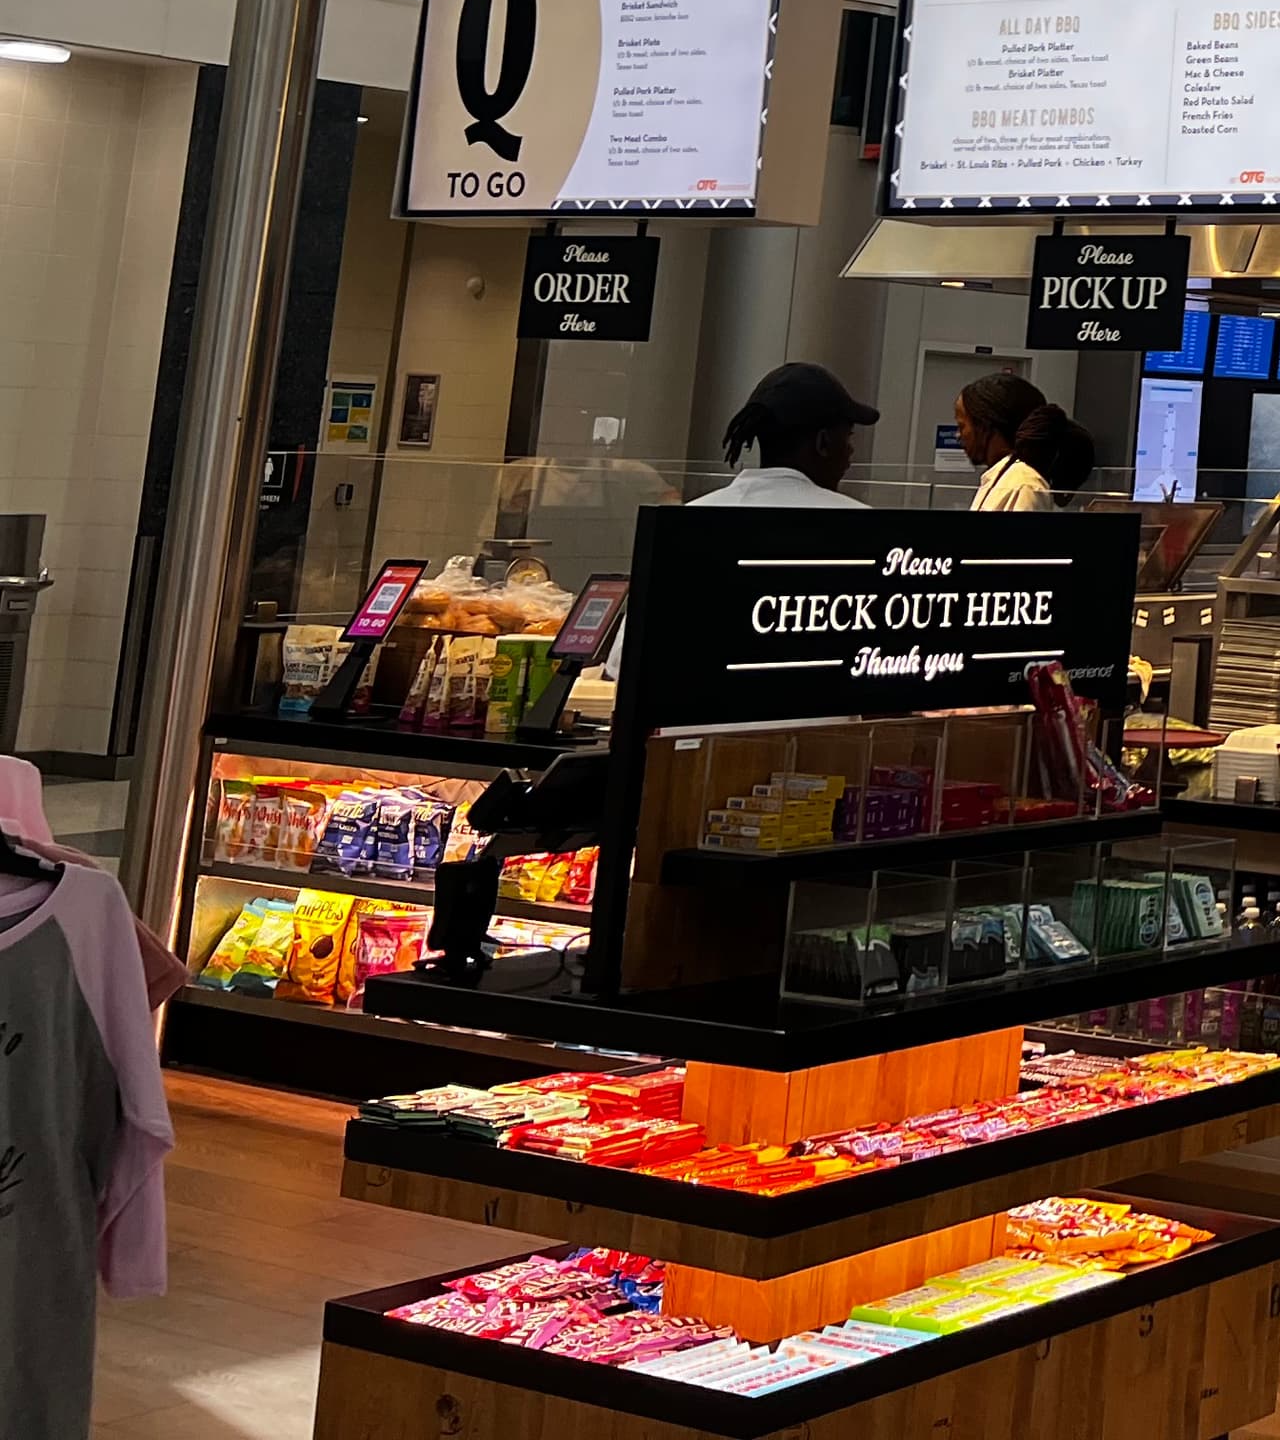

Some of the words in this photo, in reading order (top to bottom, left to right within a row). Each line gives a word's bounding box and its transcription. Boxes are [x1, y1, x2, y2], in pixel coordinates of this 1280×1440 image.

[621, 1, 645, 10] Brisket
[646, 0, 678, 9] Sandwich
[1000, 18, 1020, 36] ALL
[1025, 17, 1050, 35] DAY
[1055, 16, 1080, 34] BBQ
[1213, 12, 1240, 31] BBQ
[1002, 44, 1026, 54] Pulled
[1048, 41, 1074, 52] Platter
[1186, 41, 1212, 50] Baked
[1214, 40, 1239, 50] Beans
[1186, 55, 1212, 64] Green
[1214, 55, 1239, 64] Beans
[1008, 69, 1035, 79] Brisket
[1037, 68, 1064, 78] Platter
[1184, 70, 1201, 78] Mac
[1203, 69, 1210, 78] &
[1212, 68, 1245, 78] Cheese
[613, 87, 635, 96] Pulled
[653, 86, 676, 94] Platter
[1184, 83, 1221, 93] Coleslaw
[1183, 97, 1199, 107] Red
[1201, 96, 1229, 106] Potato
[1231, 95, 1254, 105] Salad
[971, 110, 996, 129] BBQ
[1001, 108, 1036, 127] MEAT
[1040, 107, 1095, 127] COMBOS
[1182, 111, 1211, 121] French
[1212, 111, 1233, 120] Fries
[1181, 125, 1214, 135] Roasted
[1216, 124, 1238, 134] Corn
[920, 160, 947, 170] Brisket
[969, 159, 989, 169] Louis
[1017, 158, 1043, 168] Pulled
[1072, 158, 1105, 167] Chicken
[1116, 157, 1143, 168] Turkey
[1239, 171, 1265, 183] OTG
[447, 172, 479, 198] TO
[486, 171, 526, 198] GO
[697, 179, 718, 191] OTG
[562, 244, 610, 264] Please
[1077, 244, 1134, 266] Please
[533, 272, 631, 304] ORDER
[1039, 276, 1113, 310] PICK
[1121, 275, 1168, 310] UP
[559, 313, 597, 334] Here
[1077, 321, 1121, 343] Here
[881, 546, 953, 577] Please
[751, 593, 876, 635] CHECK
[885, 592, 958, 630] OUT
[964, 590, 1054, 628] HERE
[357, 617, 371, 629] TO
[371, 617, 386, 629] GO
[850, 645, 920, 678] Thank
[924, 649, 965, 682] you
